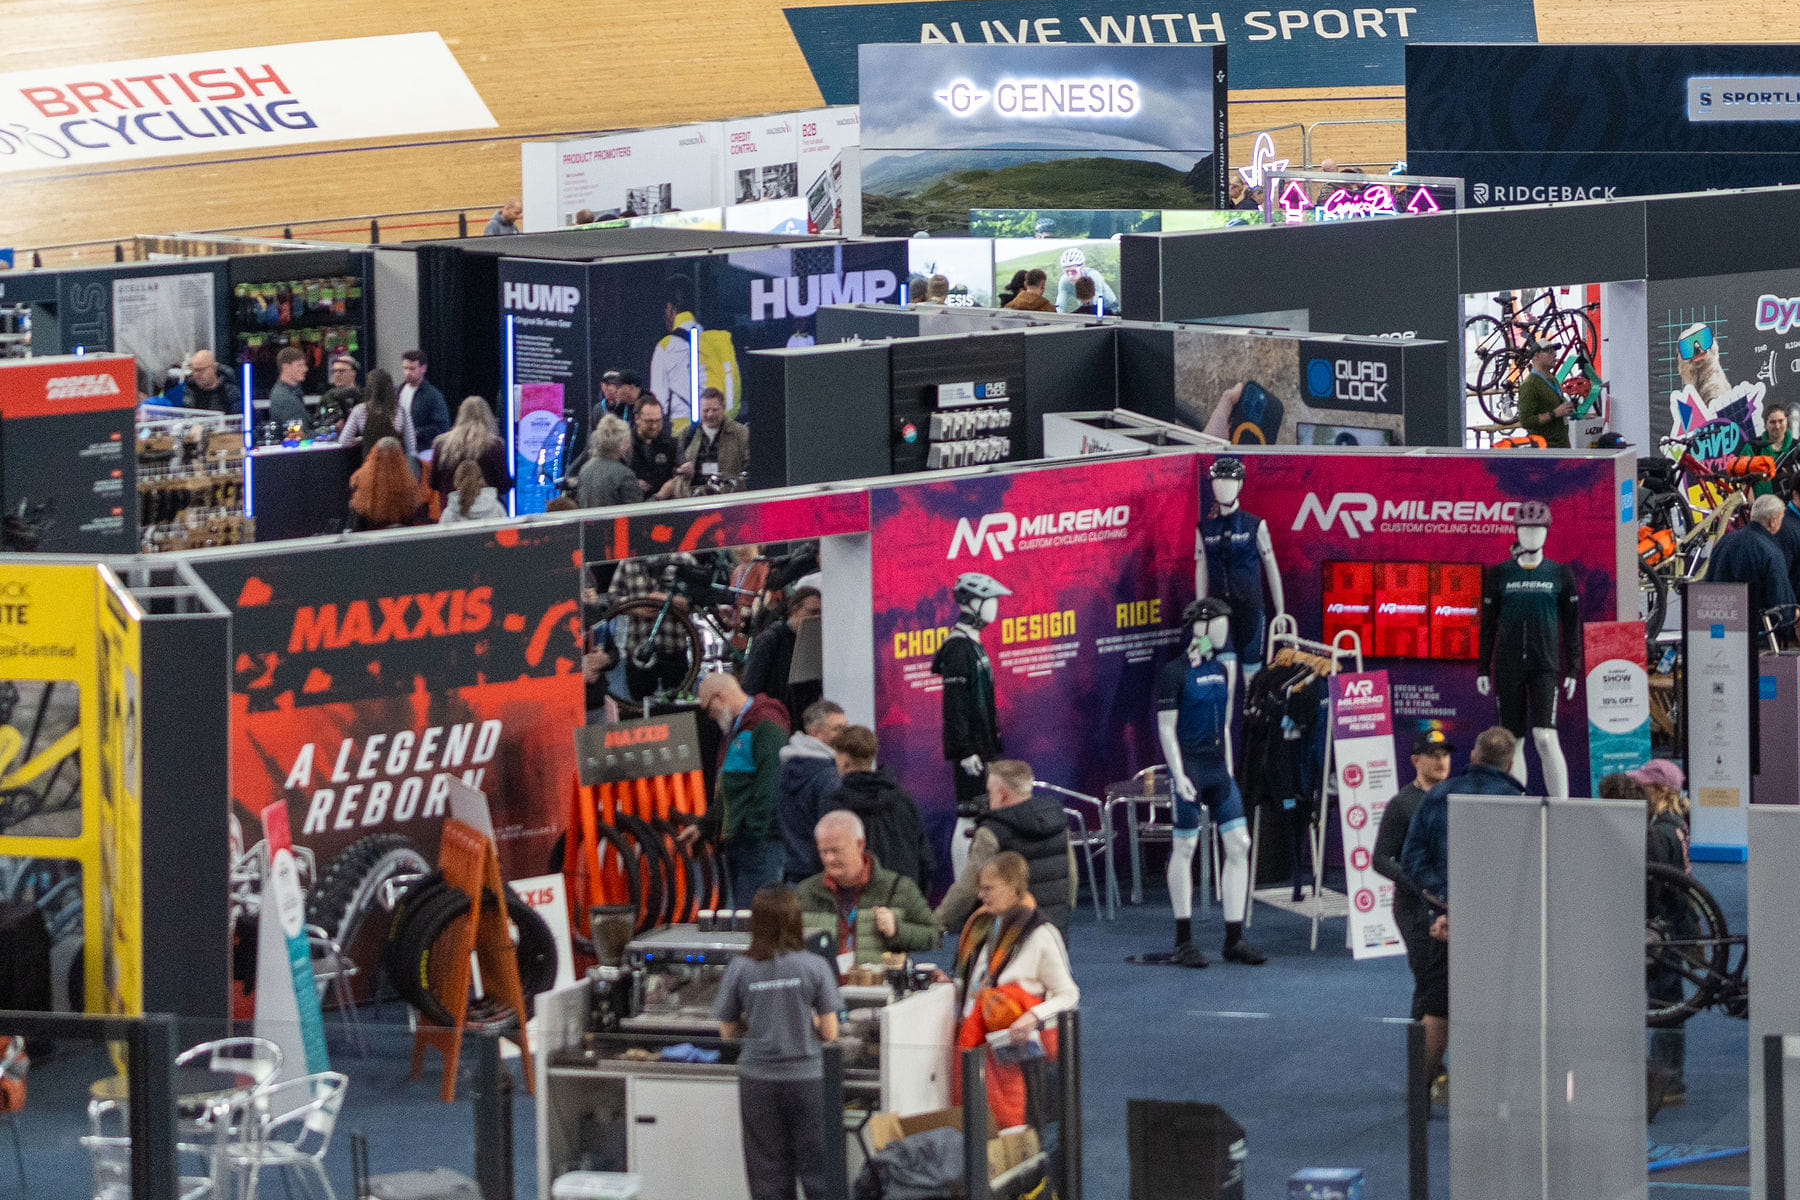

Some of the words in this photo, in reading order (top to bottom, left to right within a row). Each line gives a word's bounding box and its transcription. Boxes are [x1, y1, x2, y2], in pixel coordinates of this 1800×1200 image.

[919, 17, 1062, 44] ALIVE
[1079, 12, 1226, 44] WITH
[1244, 7, 1418, 42] SPORT
[21, 63, 291, 119] BRITISH
[996, 82, 1136, 114] GENESIS
[60, 99, 318, 150] CYCLING
[802, 122, 817, 137] B2B
[730, 130, 752, 144] CREDIT
[730, 142, 757, 155] CONTROL
[563, 148, 592, 165] PRODUCT
[593, 145, 631, 162] PROMOTERS
[1495, 185, 1617, 202] RIDGEBACK
[1335, 360, 1387, 381] QUAD
[1335, 380, 1388, 403] LOCK
[1020, 505, 1130, 537] MILREMO
[1380, 523, 1423, 533] CUSTOM
[1424, 523, 1468, 534] CYCLING
[1018, 538, 1053, 552] CUSTOM
[1053, 534, 1087, 548] CYCLING
[1088, 528, 1128, 544] CLOTHING
[1506, 580, 1554, 590] MILREMO
[288, 586, 493, 653] MAXXIS
[1115, 599, 1162, 629] RIDE
[1002, 609, 1077, 645] DESIGN
[1602, 674, 1632, 683] SHOW
[1337, 694, 1384, 707] MILREMO
[604, 724, 669, 748] MAXXIS
[284, 742, 315, 790] A
[332, 718, 503, 784] LEGEND
